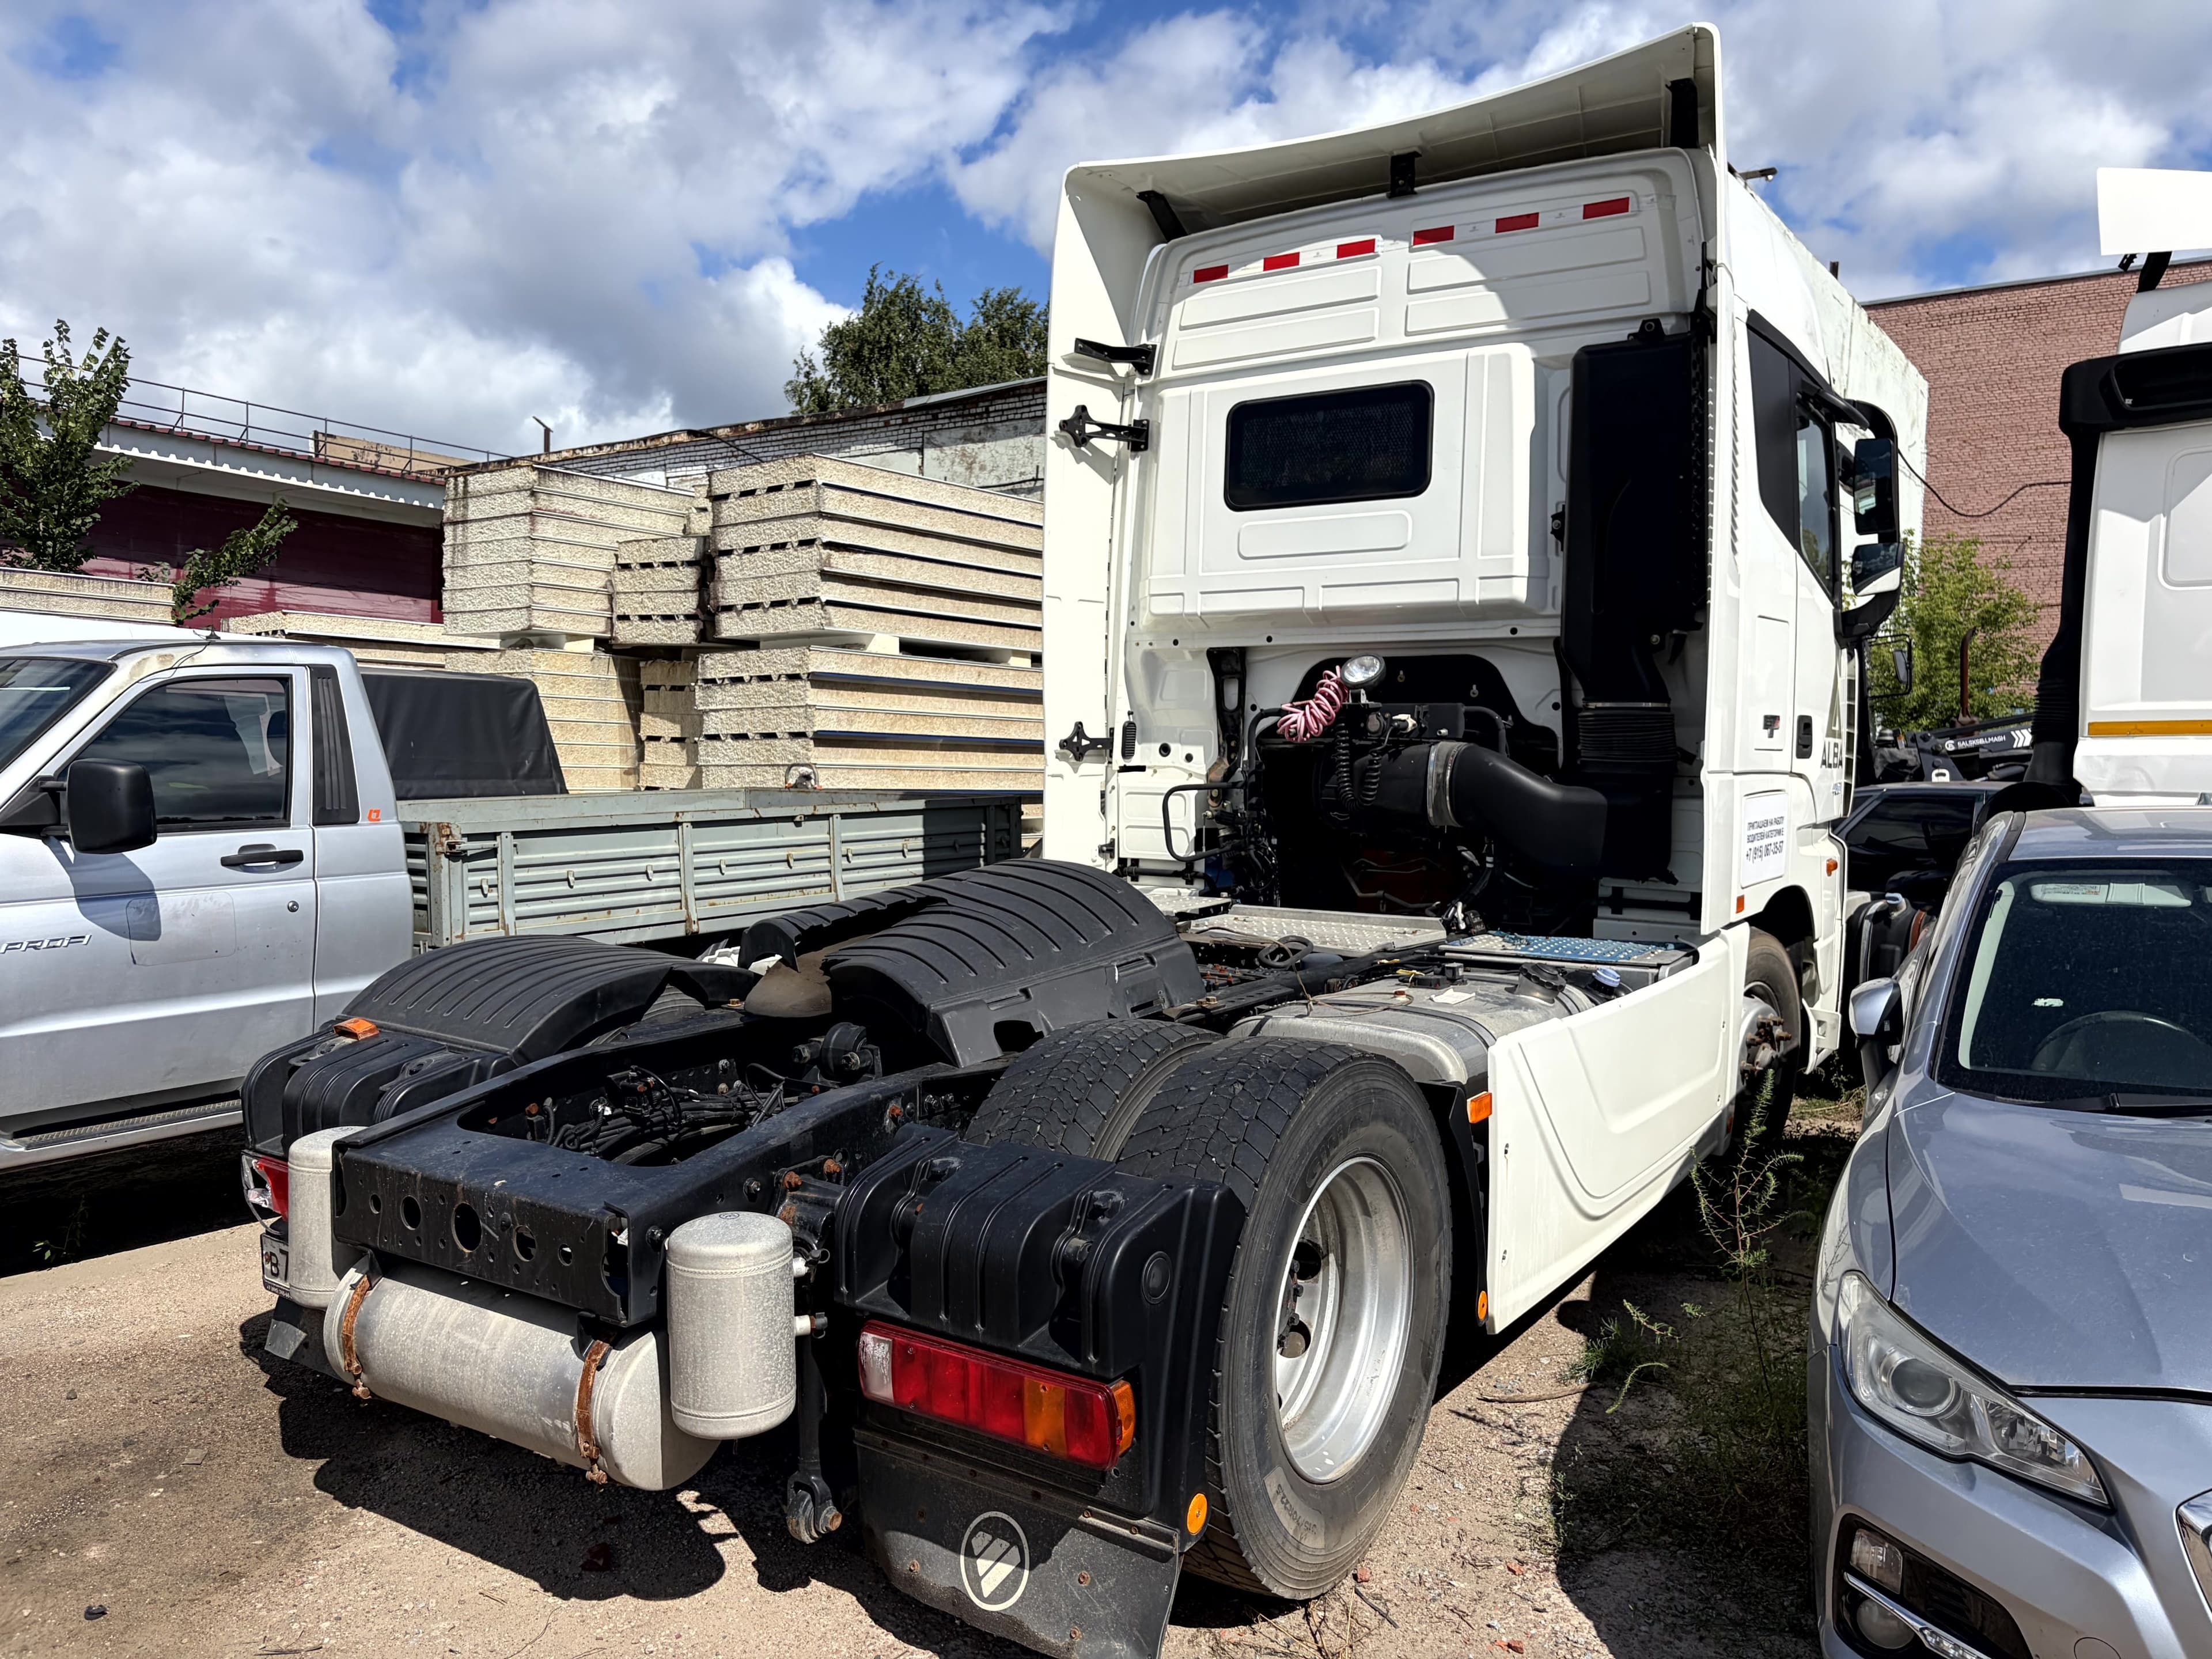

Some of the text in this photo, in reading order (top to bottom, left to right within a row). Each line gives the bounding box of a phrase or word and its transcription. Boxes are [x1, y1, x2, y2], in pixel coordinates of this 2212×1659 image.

[1820, 741, 1843, 768] ALBA
[1746, 848, 1752, 861] +7
[1752, 845, 1763, 863] (915)
